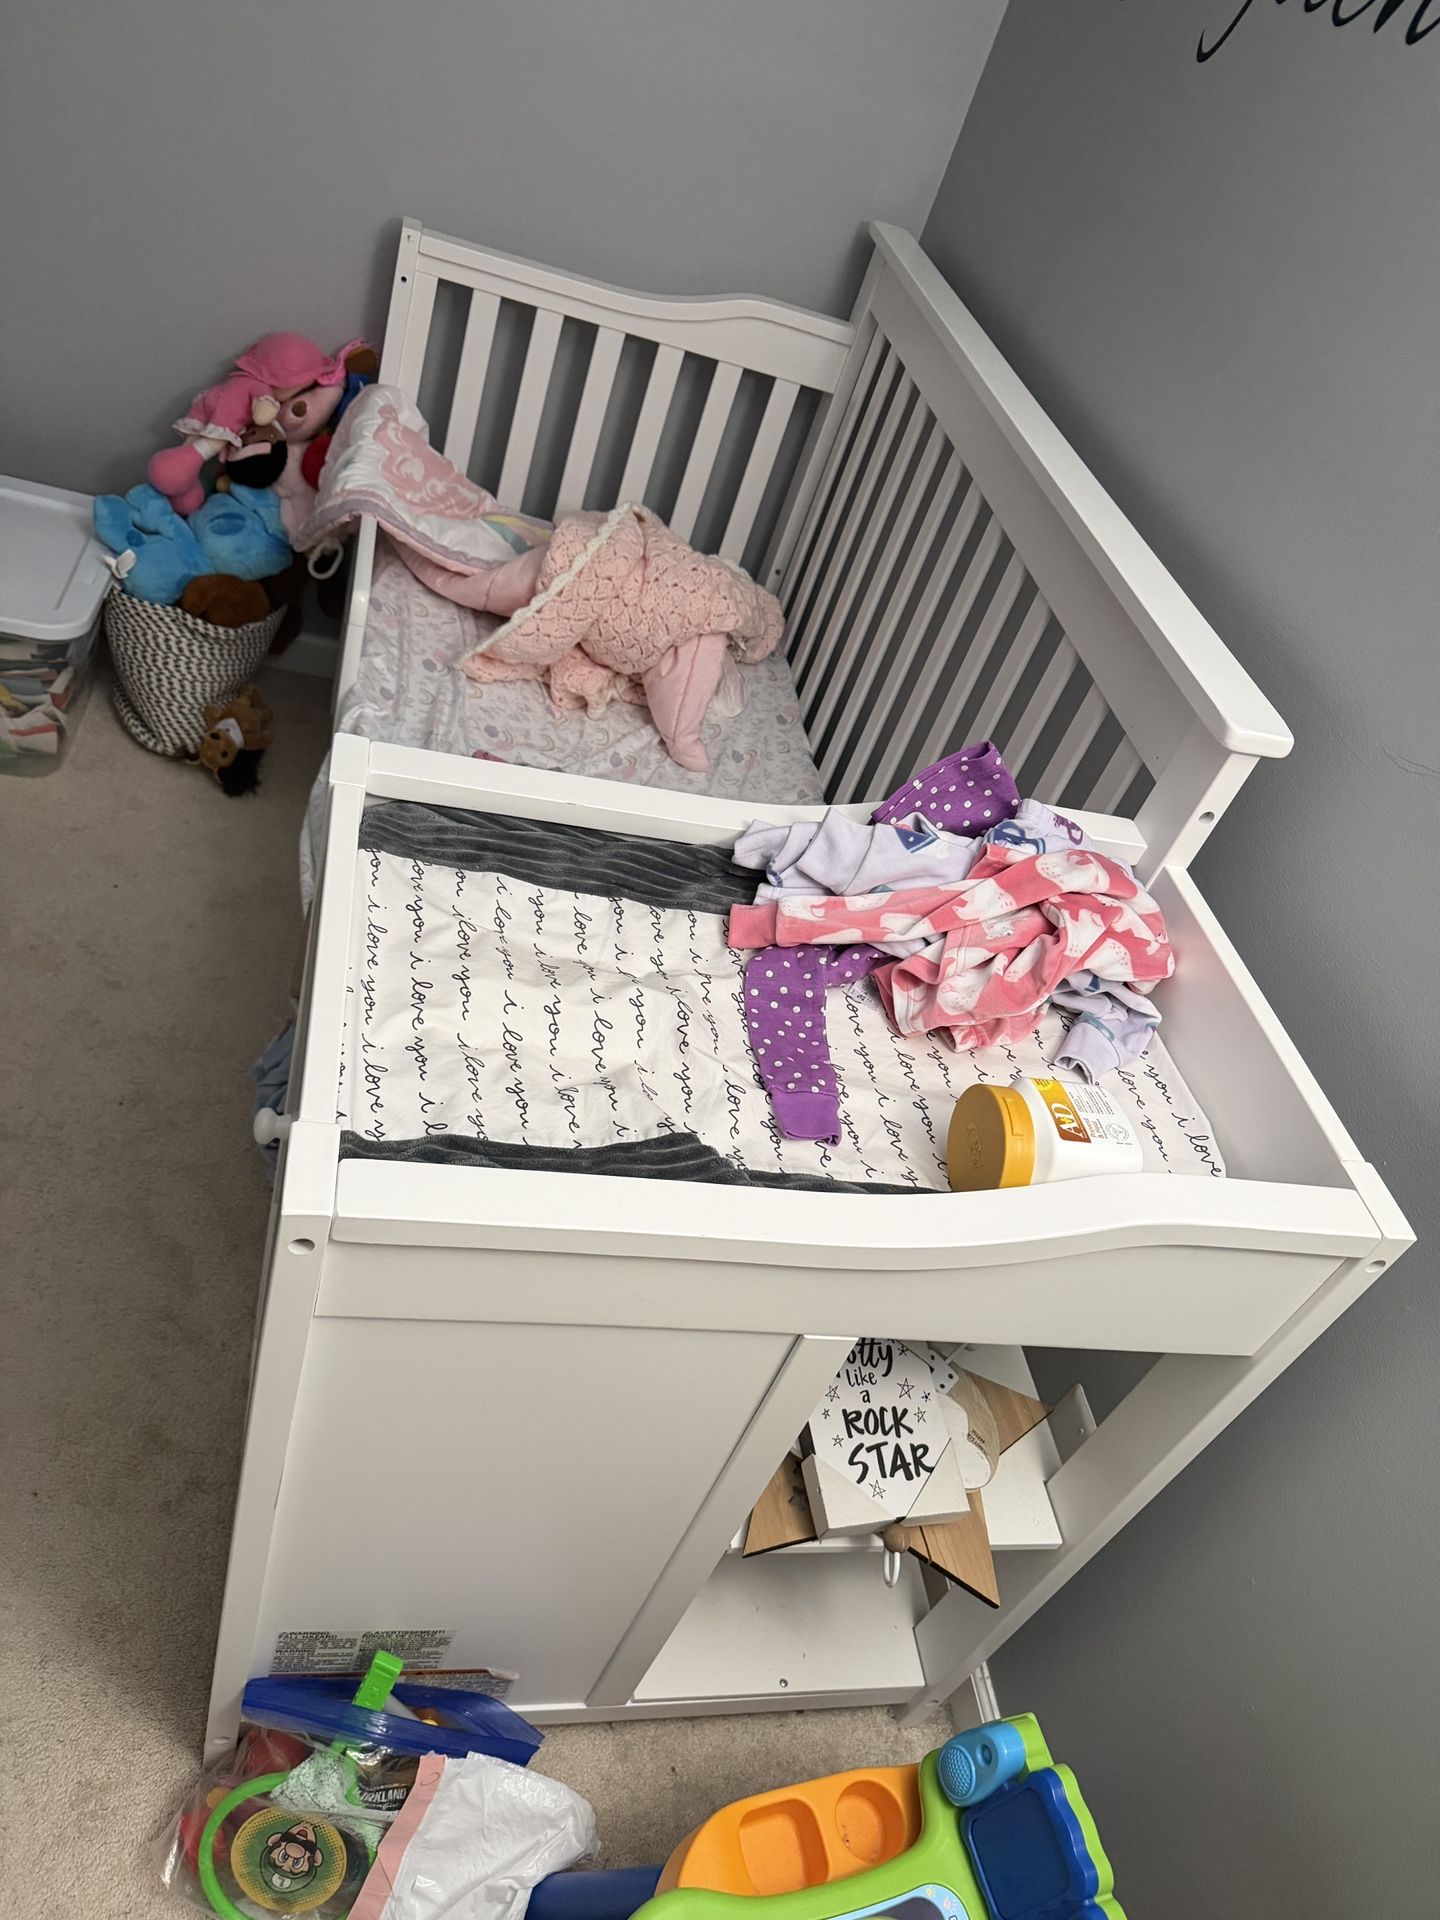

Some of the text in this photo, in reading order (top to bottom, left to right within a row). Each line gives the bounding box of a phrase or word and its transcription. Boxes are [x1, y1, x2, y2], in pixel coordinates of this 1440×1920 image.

[367, 894, 387, 913] i
[406, 894, 425, 944] you
[528, 888, 545, 935] you
[687, 909, 699, 941] ou
[366, 917, 388, 970] love
[533, 943, 554, 959] i
[573, 905, 593, 955] love
[410, 951, 432, 970] i
[614, 943, 634, 961] i
[689, 948, 709, 965] i
[537, 959, 562, 990] love
[590, 987, 612, 1004] i
[361, 974, 376, 1026] you
[411, 977, 434, 1031] love
[452, 869, 489, 1142] ou i love you i love yo
[493, 876, 529, 1130] i love you i love you
[628, 987, 646, 1049] you
[362, 1033, 384, 1054] i
[543, 994, 562, 1057] you
[591, 1010, 614, 1073] love
[675, 995, 694, 1055] love
[702, 1009, 721, 1055] you
[887, 1027, 907, 1044] i
[1032, 1029, 1043, 1049] ou
[405, 1036, 428, 1081] you
[549, 1064, 572, 1083] i
[634, 1059, 655, 1076] i
[854, 1042, 877, 1083] you
[894, 1048, 920, 1092] love
[926, 1045, 952, 1089] you
[973, 1064, 996, 1082] i
[363, 1058, 388, 1113] love
[419, 1092, 444, 1114] i
[593, 1076, 618, 1112] you
[673, 1062, 693, 1114] you
[874, 1088, 897, 1108] i
[554, 1086, 581, 1134] love
[612, 1120, 638, 1137] i
[724, 1079, 746, 1140] love
[912, 1094, 936, 1144] you
[1114, 1066, 1146, 1110] love
[1141, 1114, 1169, 1163] you
[1143, 1064, 1222, 1178] you i love
[760, 1111, 784, 1161] you
[880, 1114, 909, 1162] love
[725, 1145, 749, 1171] yo
[860, 1160, 885, 1179] i
[846, 1338, 894, 1378] otty
[846, 1367, 878, 1387] like
[860, 1389, 871, 1404] a
[842, 1406, 914, 1438] ROCK
[848, 1441, 936, 1484] STAR
